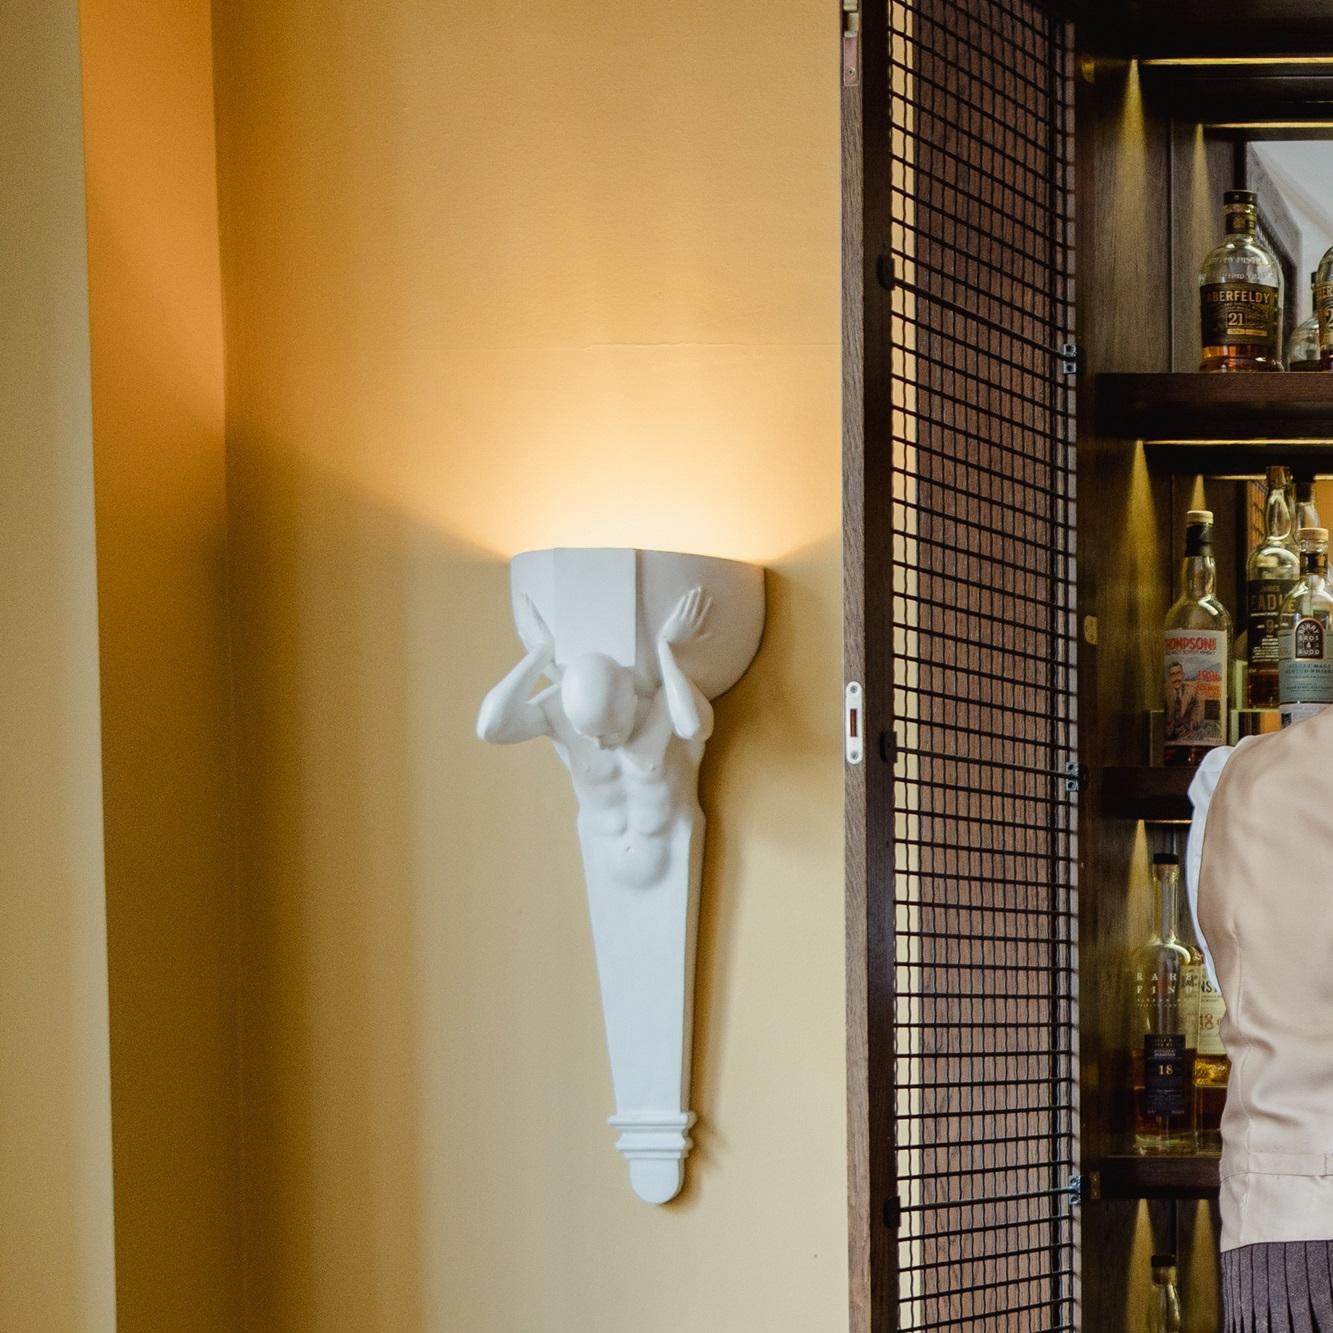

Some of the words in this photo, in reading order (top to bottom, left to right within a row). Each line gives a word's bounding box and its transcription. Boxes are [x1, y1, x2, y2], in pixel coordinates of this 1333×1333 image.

[1208, 290, 1270, 304] ABERFELDY
[1228, 312, 1245, 325] 21
[1158, 1064, 1174, 1076] 18
